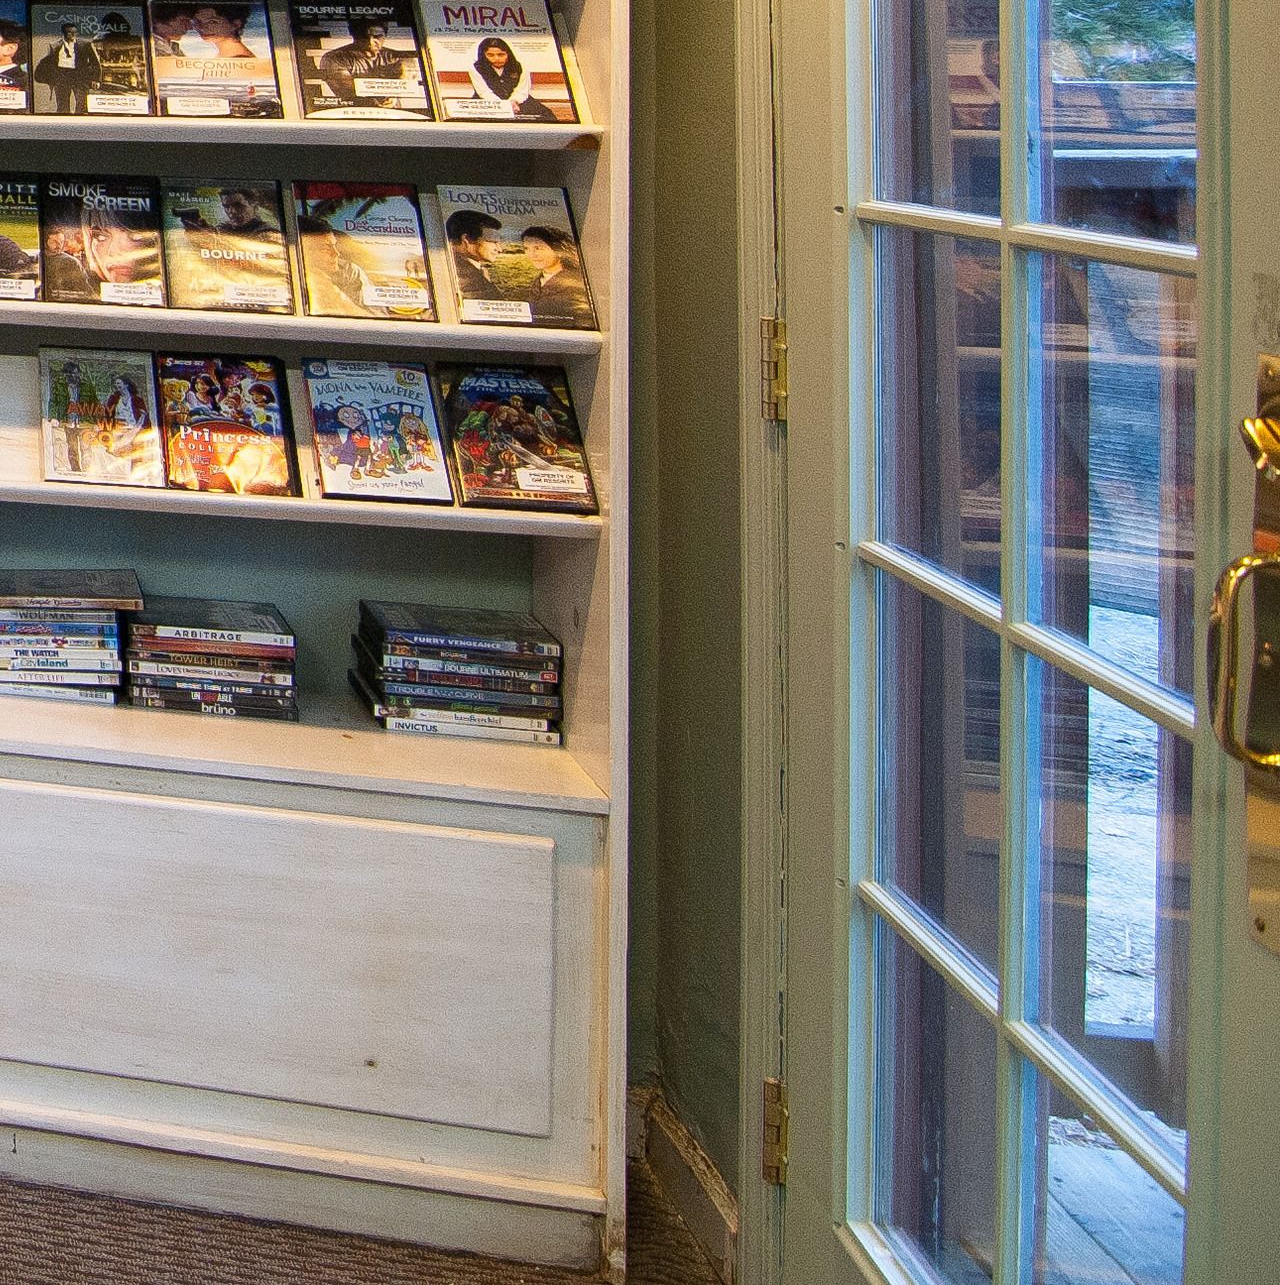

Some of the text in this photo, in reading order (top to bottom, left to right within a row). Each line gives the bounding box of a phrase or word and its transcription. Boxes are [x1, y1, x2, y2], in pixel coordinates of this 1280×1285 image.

[298, 5, 395, 15] BOURNE LEGACY
[442, 4, 539, 27] MIRAL
[44, 12, 99, 25] CASINO
[80, 21, 130, 33] ROYALE
[175, 59, 256, 71] BECOMING
[48, 181, 107, 198] SMOKE
[83, 195, 151, 212] SCREEN
[484, 203, 537, 215] DREAM
[344, 219, 416, 235] Descendants
[200, 248, 267, 260] BOURNE
[461, 376, 544, 389] MASTERS
[314, 381, 352, 396] MONA
[371, 381, 425, 403] VAMPIRE
[67, 401, 116, 416] AWAY
[180, 424, 273, 445] Princess
[18, 611, 74, 621] WOLFMAN
[174, 629, 242, 641] ARBITRAGE
[413, 636, 502, 649] FURRY VENGEANCE
[14, 649, 59, 658] THE WATCH
[37, 658, 69, 668] Island
[170, 654, 240, 668] TOWER HEIST
[480, 668, 528, 680] ULTIMATUM
[392, 685, 433, 696] TROUBLE
[201, 702, 236, 715] brüno
[394, 721, 439, 733] INVICTUS
